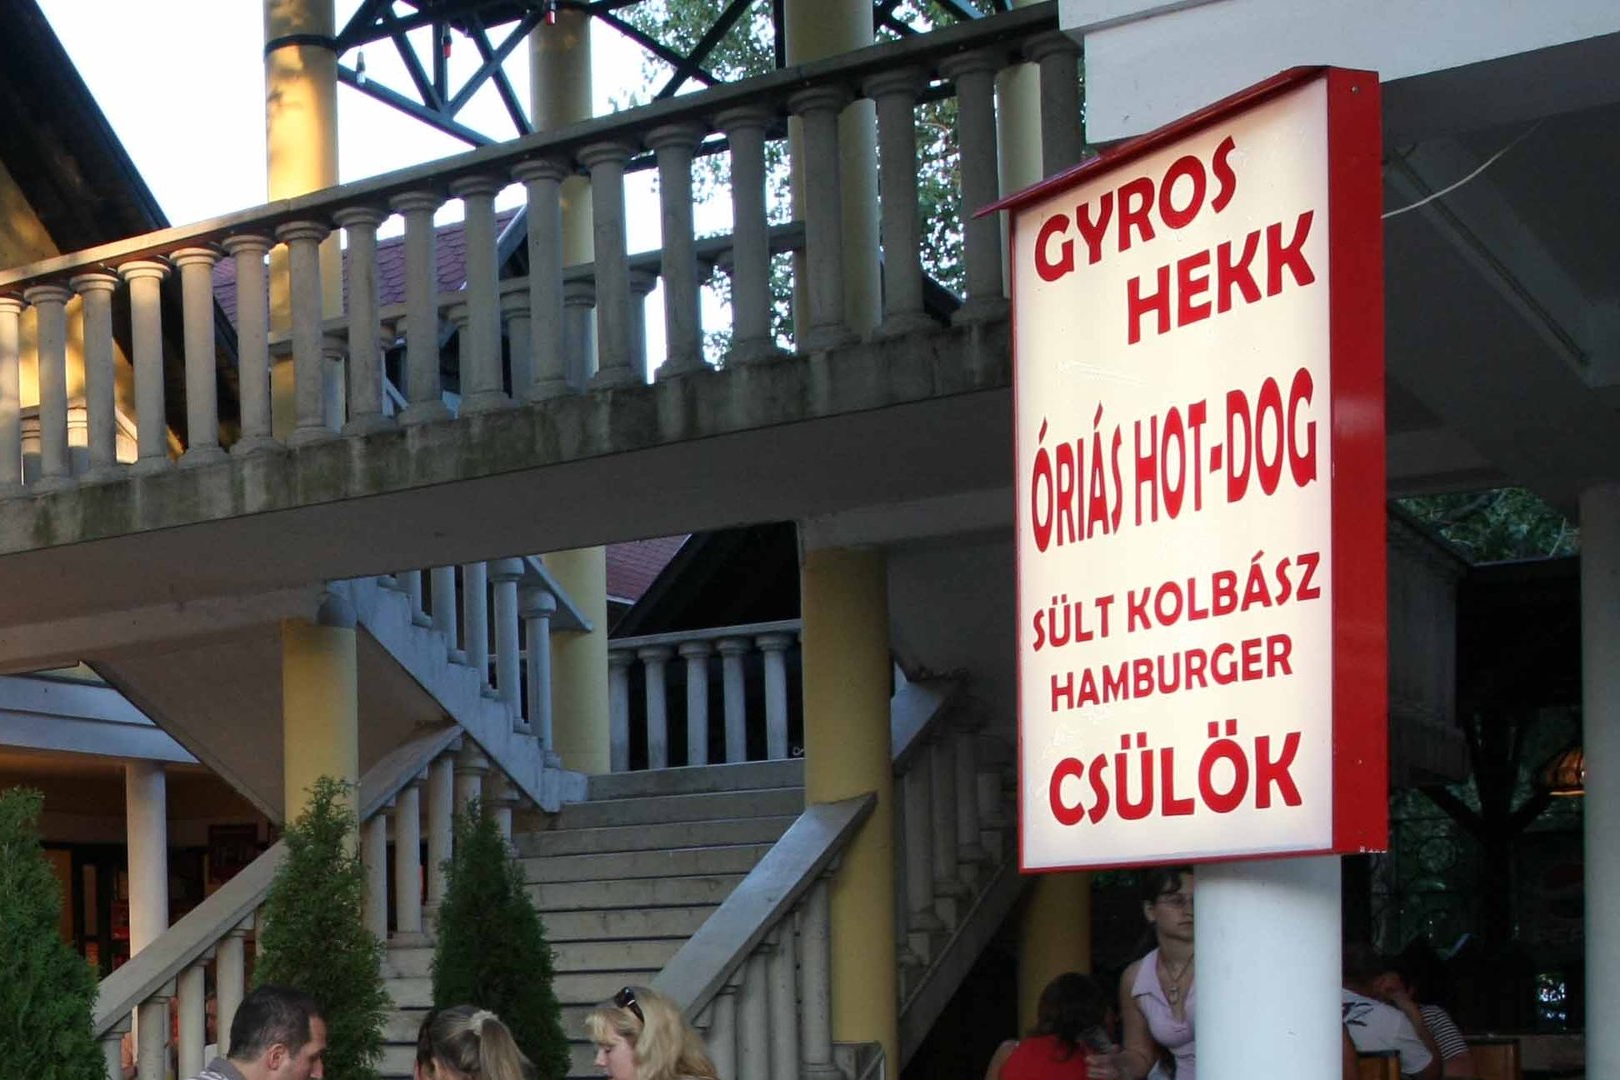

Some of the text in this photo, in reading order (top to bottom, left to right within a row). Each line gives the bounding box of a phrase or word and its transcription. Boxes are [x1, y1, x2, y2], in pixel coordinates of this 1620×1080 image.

[1034, 134, 1238, 283] GYROS
[1126, 209, 1317, 345] HEKK
[1031, 366, 1318, 553] ÓRIÁS HOT-DOG
[1032, 549, 1321, 652] SÜLT KOLBÁSZ
[1050, 633, 1293, 712] HAMBURGER
[1048, 718, 1303, 826] CSÜLÖK
